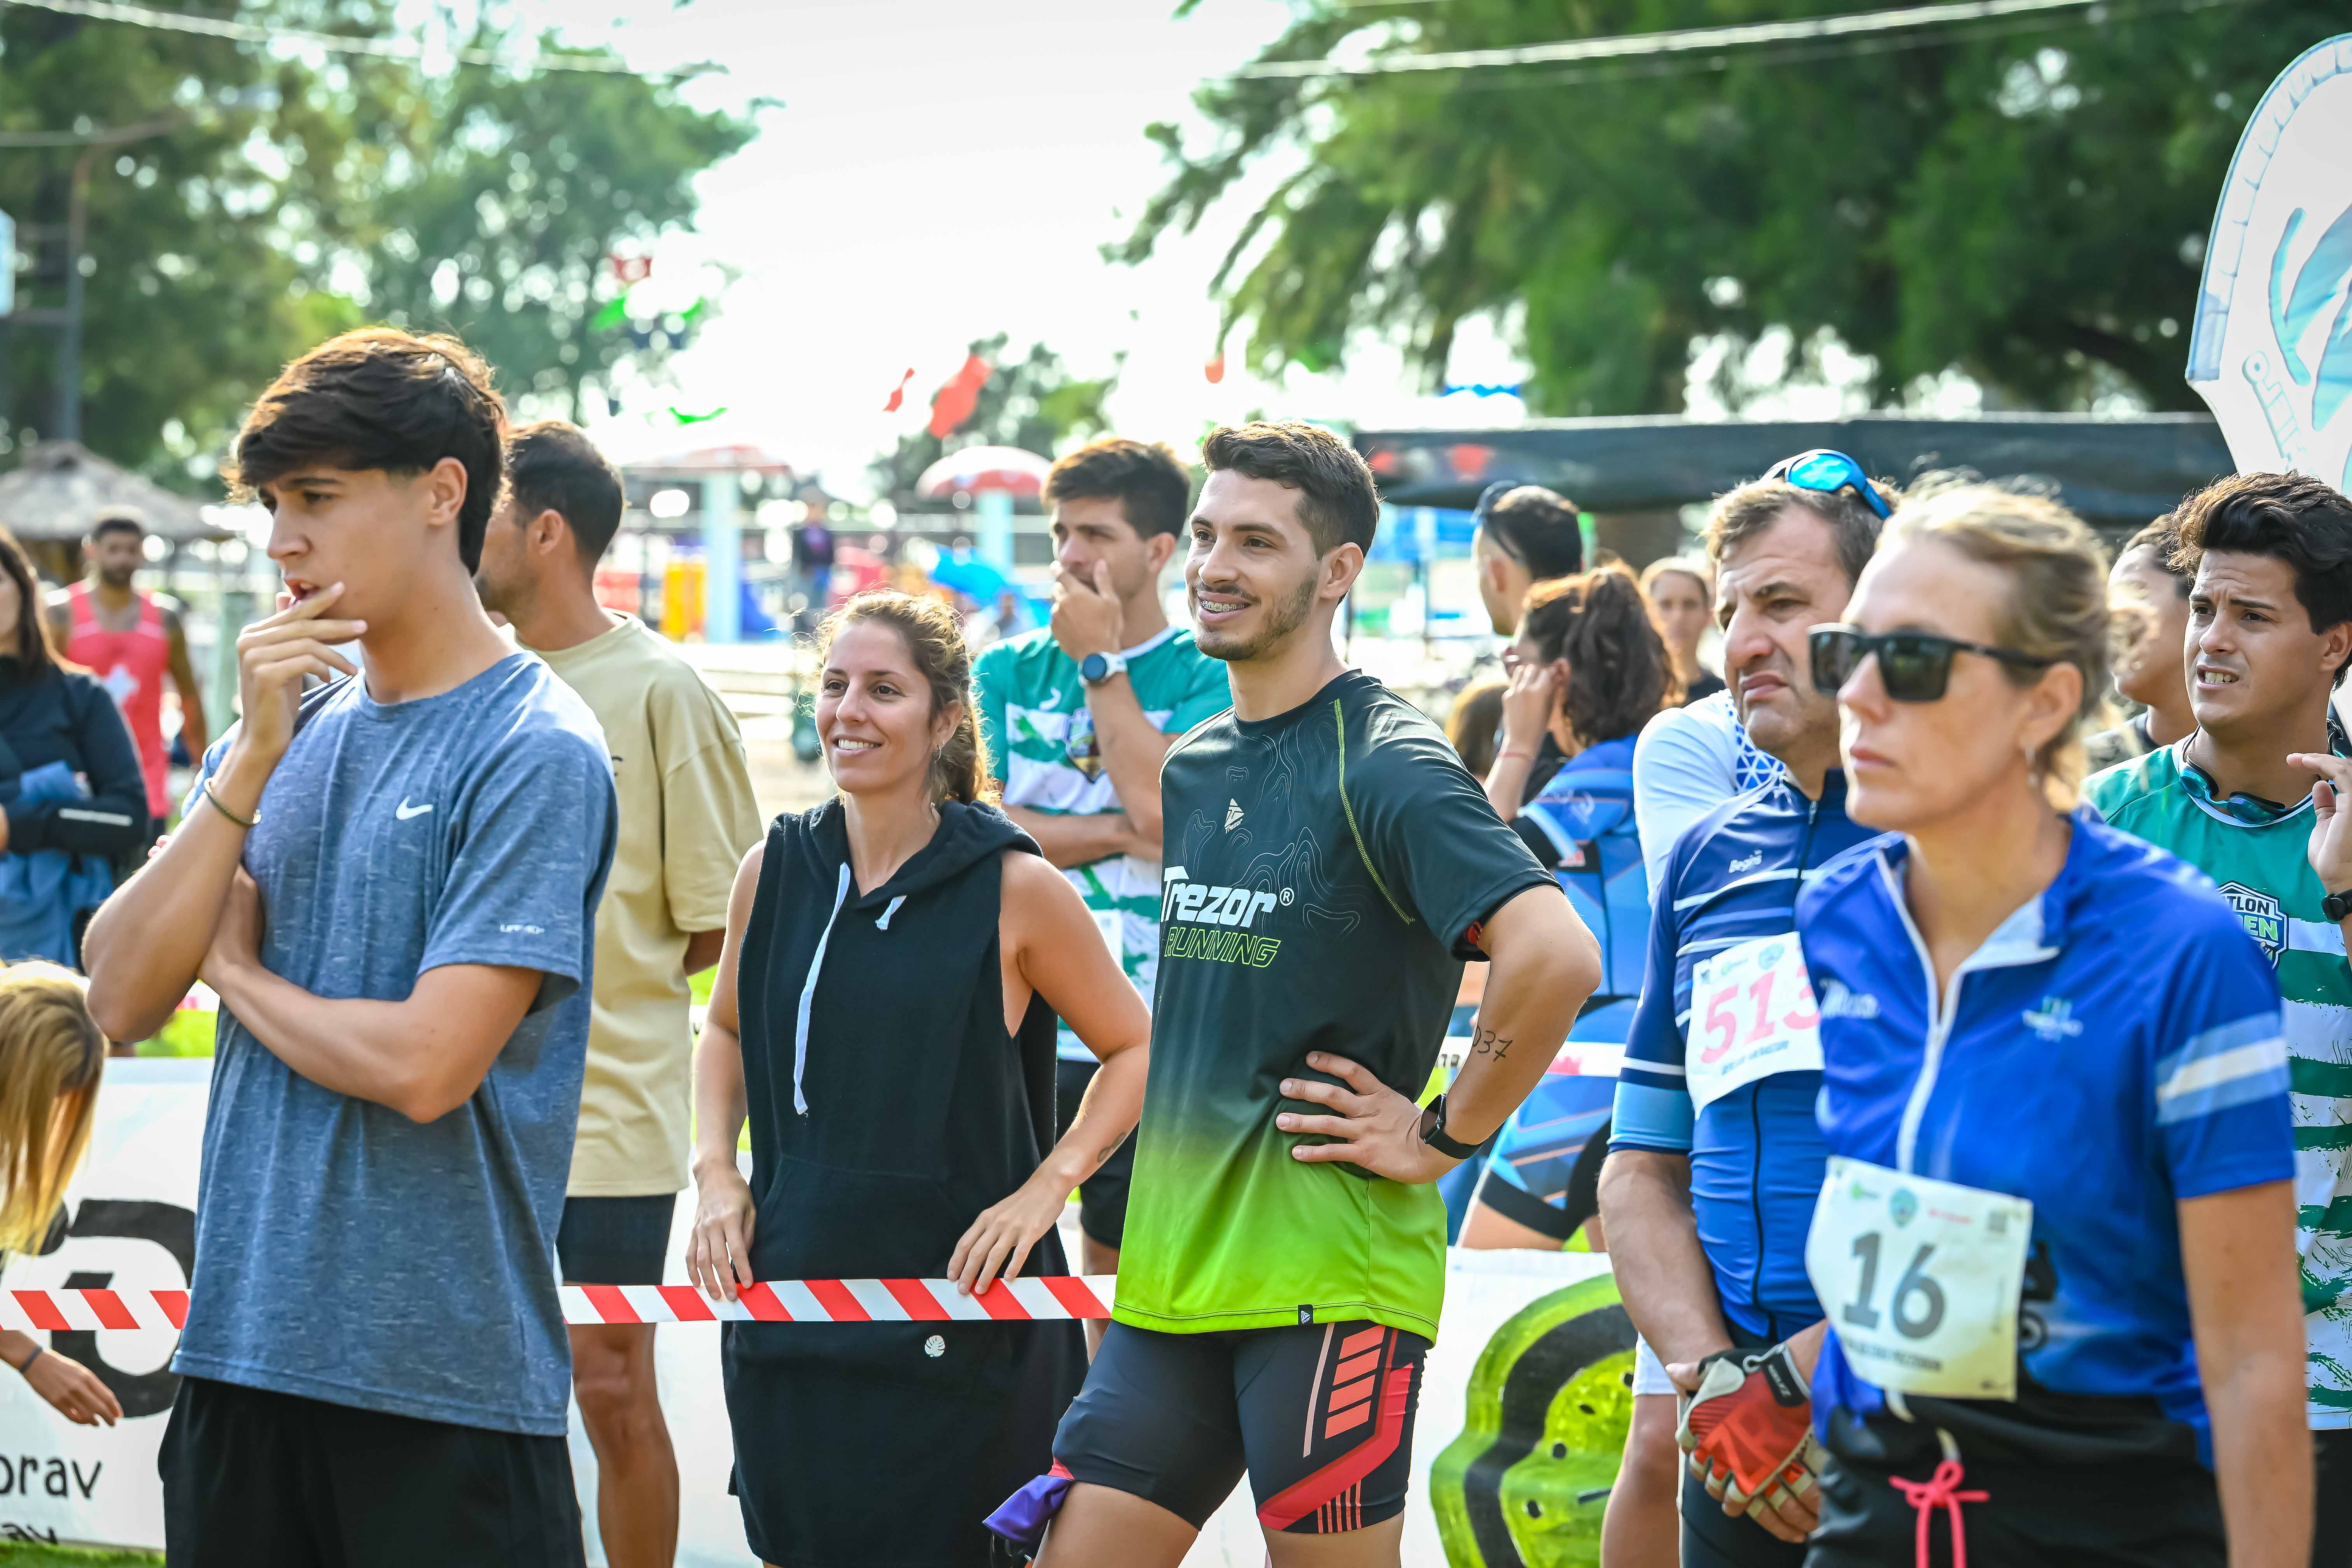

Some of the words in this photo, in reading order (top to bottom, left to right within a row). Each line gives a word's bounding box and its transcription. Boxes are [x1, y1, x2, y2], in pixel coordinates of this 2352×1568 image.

[2222, 896, 2270, 915] TLON
[2239, 915, 2278, 941] EN
[1164, 927, 1281, 968] RUNNING
[1843, 1231, 1946, 1339] 16
